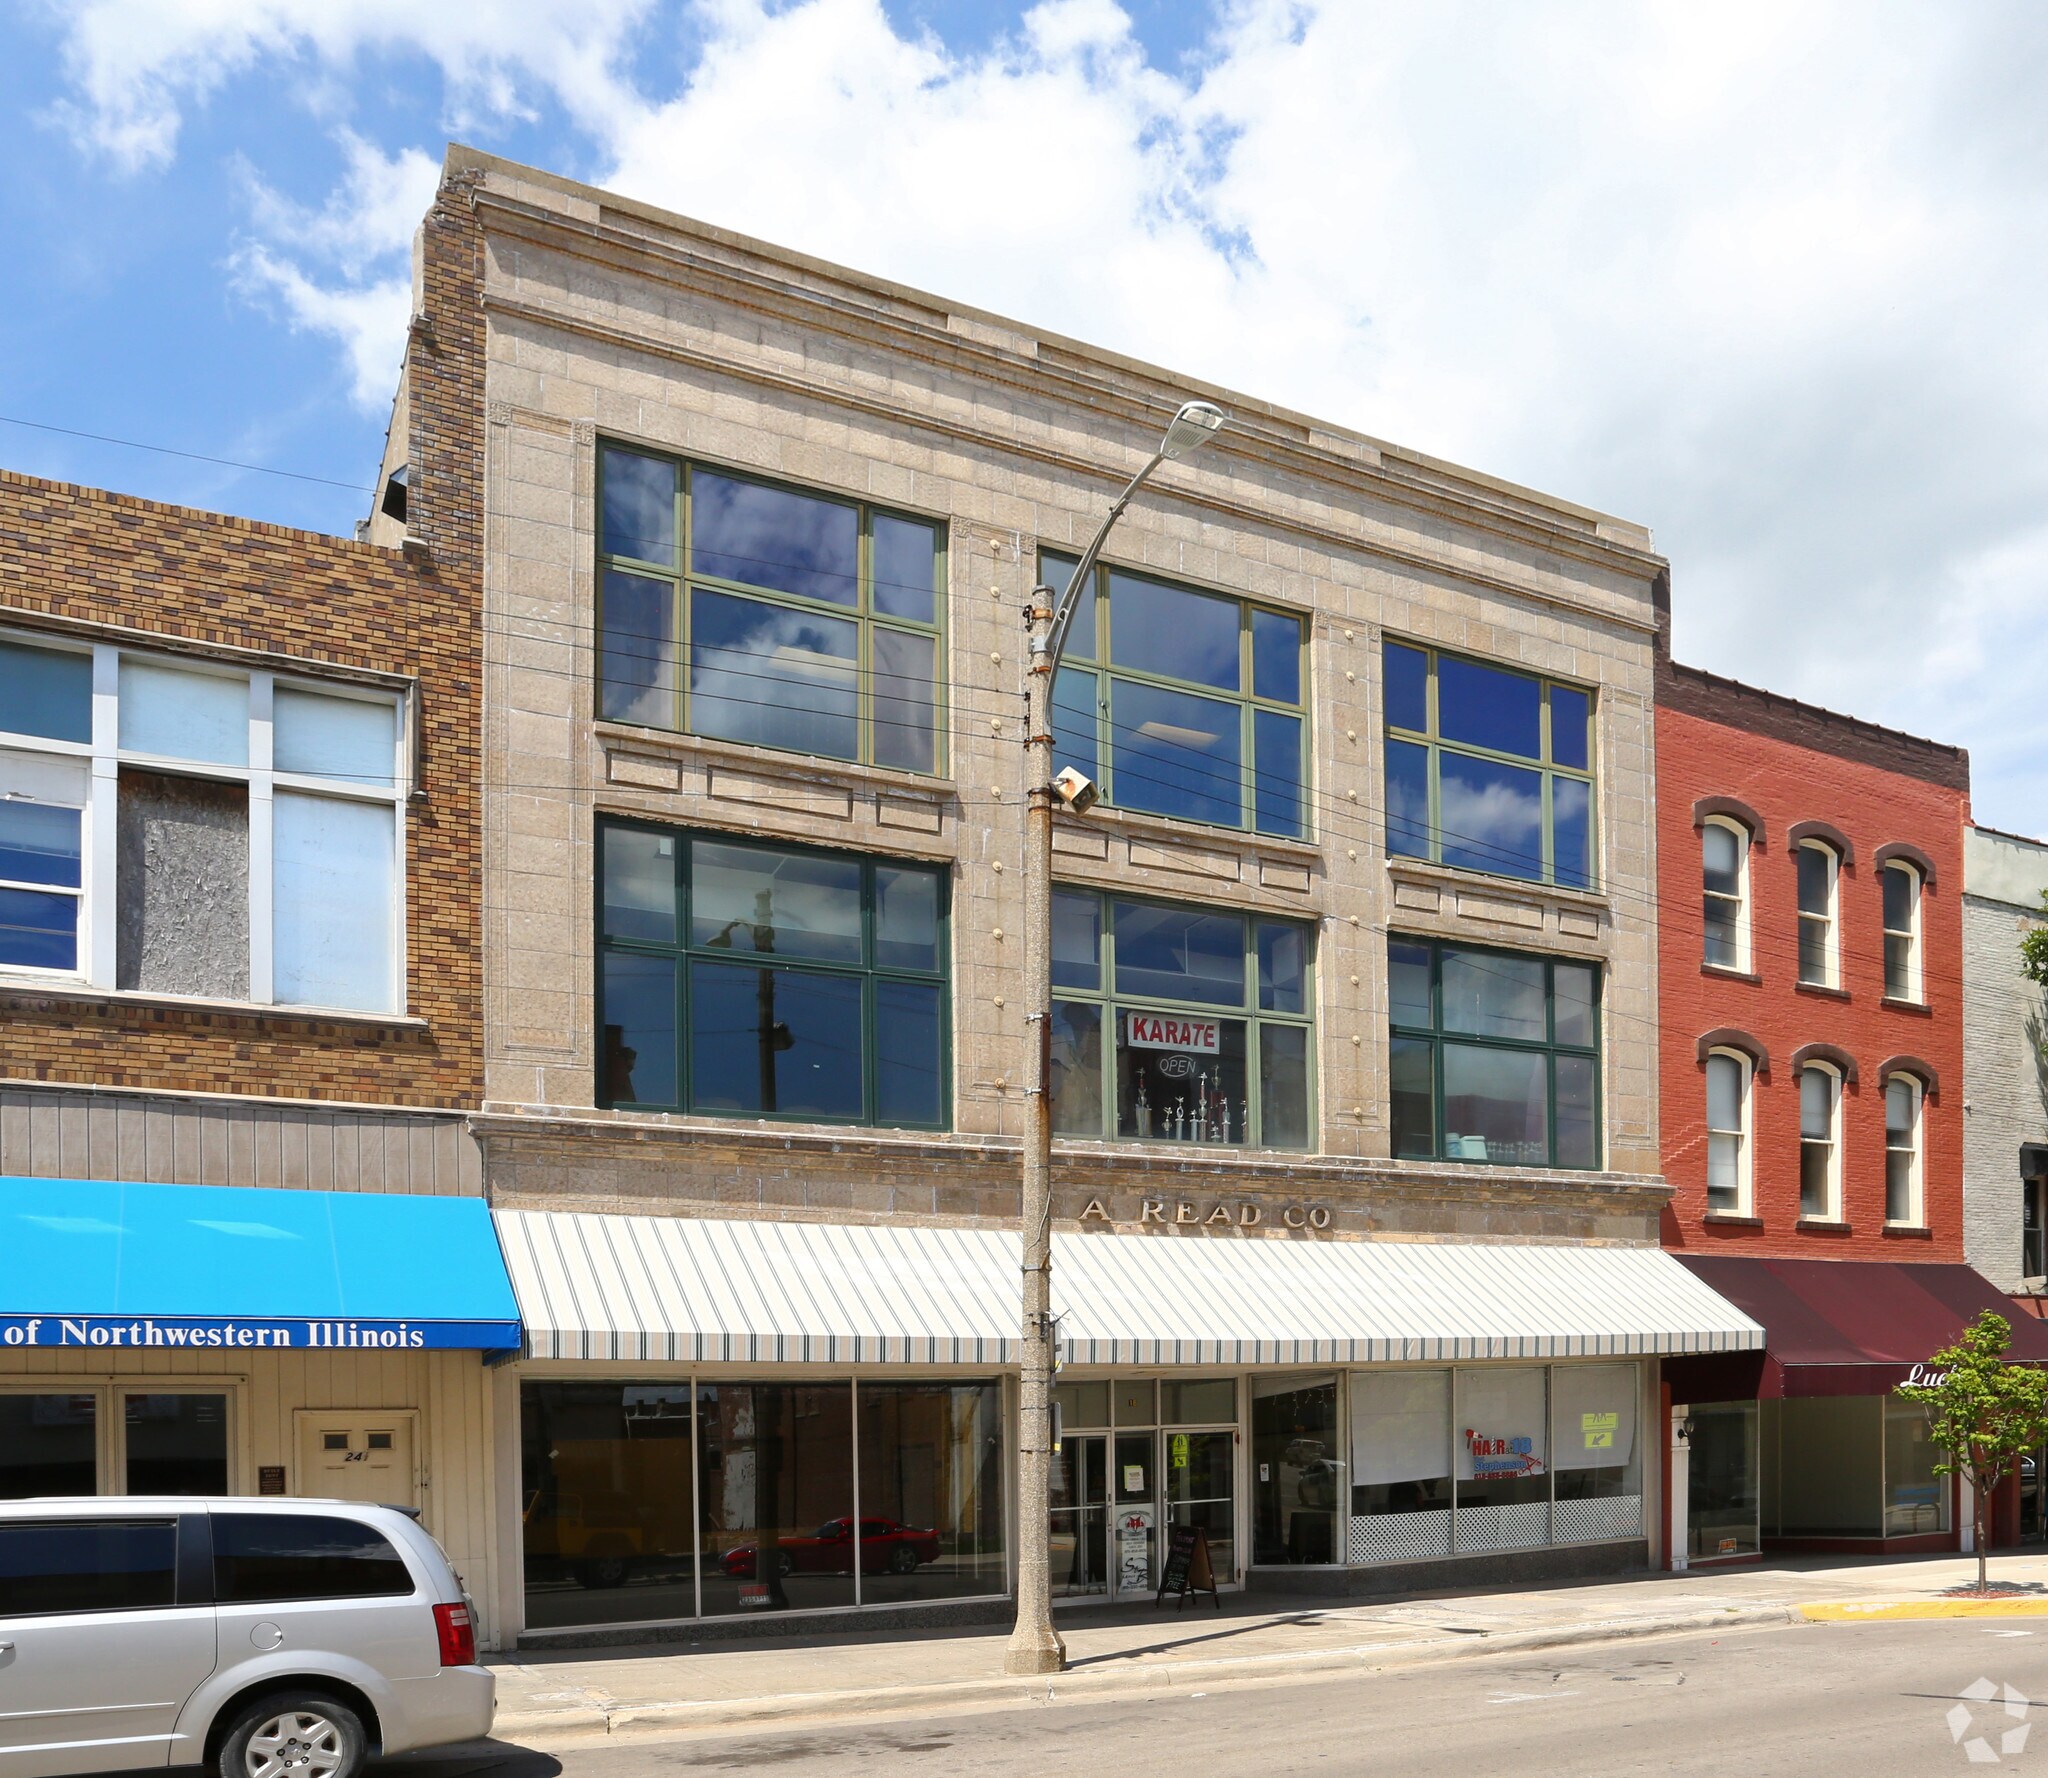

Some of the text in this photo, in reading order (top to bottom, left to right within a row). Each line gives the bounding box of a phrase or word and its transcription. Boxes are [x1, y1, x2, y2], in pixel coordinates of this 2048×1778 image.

[1133, 1016, 1216, 1048] KARATE
[1159, 1057, 1197, 1074] OPEN
[1078, 1197, 1330, 1229] A READ CO
[3, 1319, 425, 1348] of Northwestern Illinois
[1472, 1438, 1505, 1456] HAIR
[1511, 1437, 1532, 1454] 18
[1473, 1460, 1527, 1472] Stephenson
